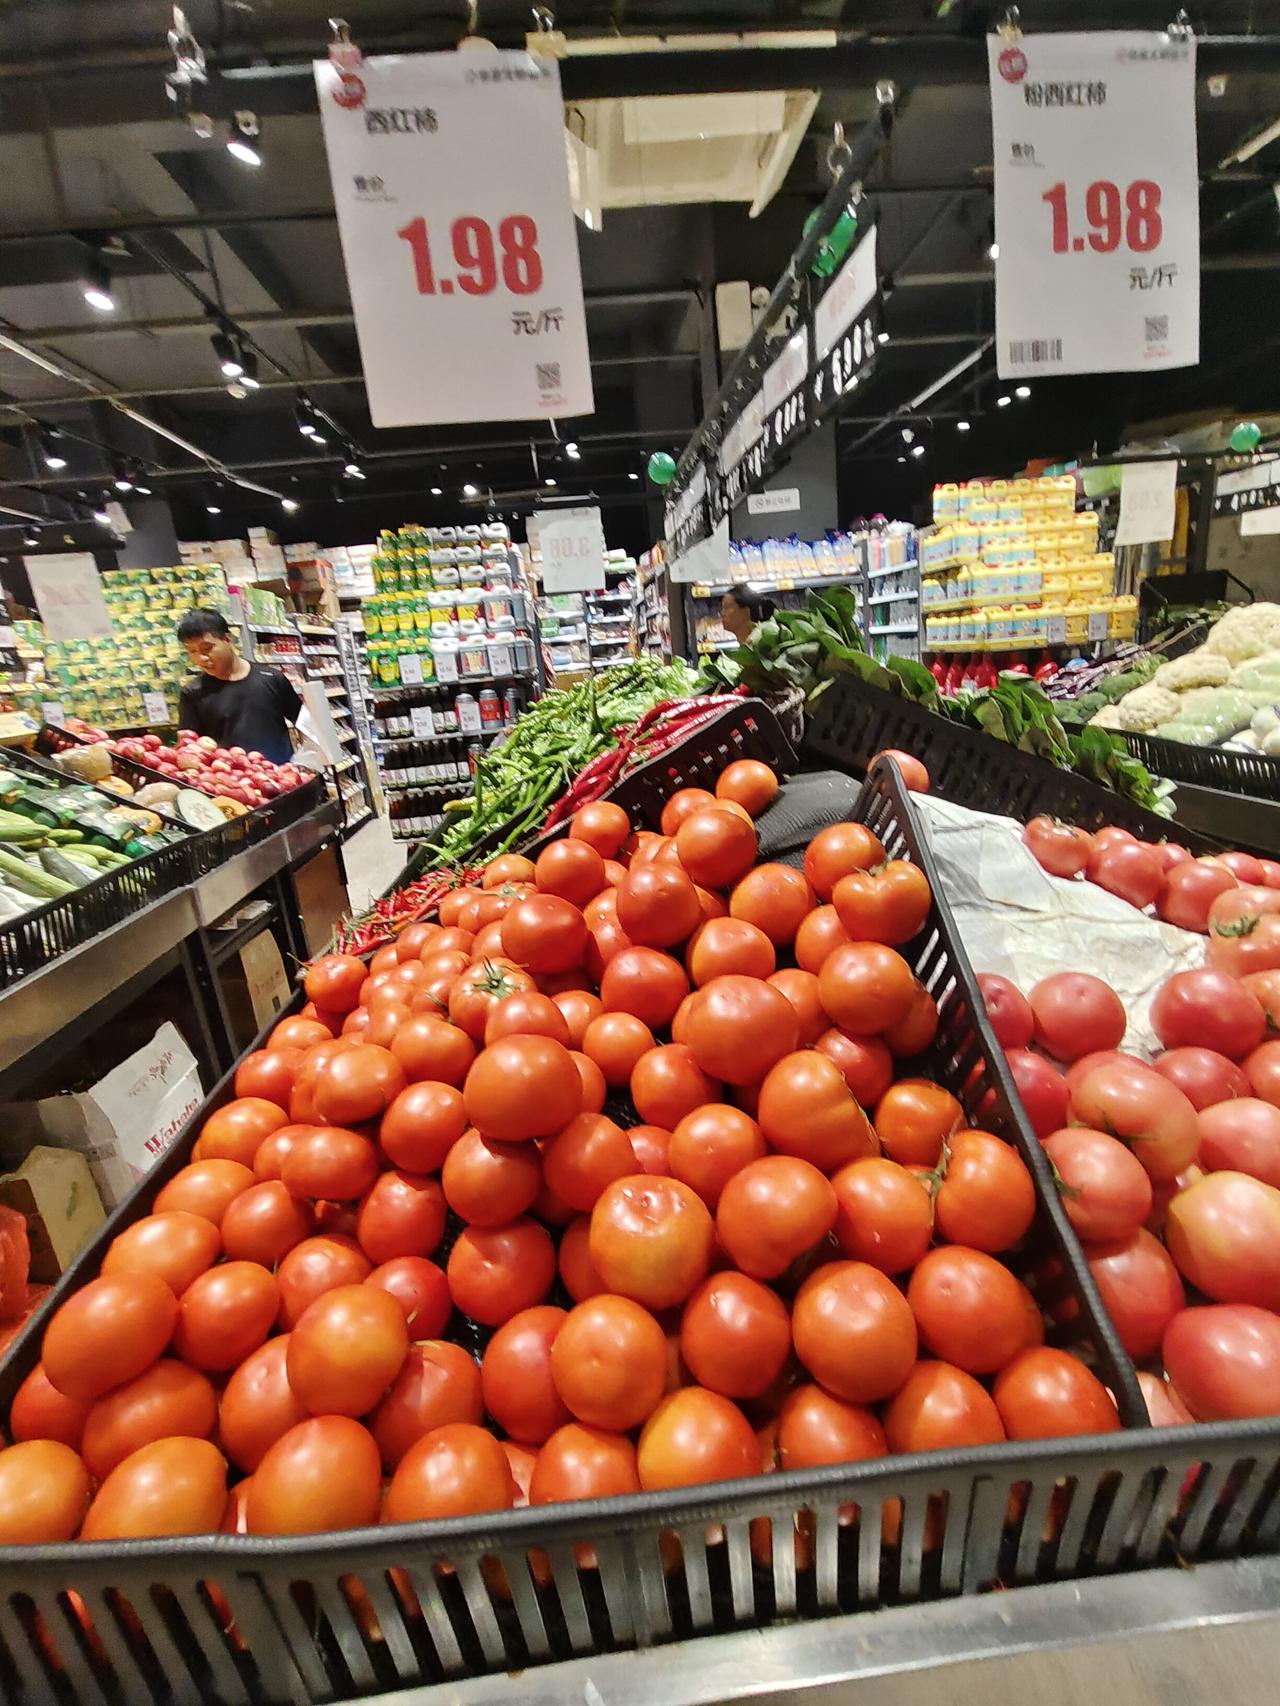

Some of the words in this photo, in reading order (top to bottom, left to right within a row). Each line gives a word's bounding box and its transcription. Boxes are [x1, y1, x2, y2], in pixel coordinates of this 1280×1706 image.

[1024, 82, 1107, 108] 粉西红柿
[365, 107, 438, 135] 西红柿
[1042, 180, 1163, 254] 1.98
[397, 213, 543, 296] 1.98
[1129, 264, 1178, 291] 元/斤
[512, 307, 564, 335] 元/斤
